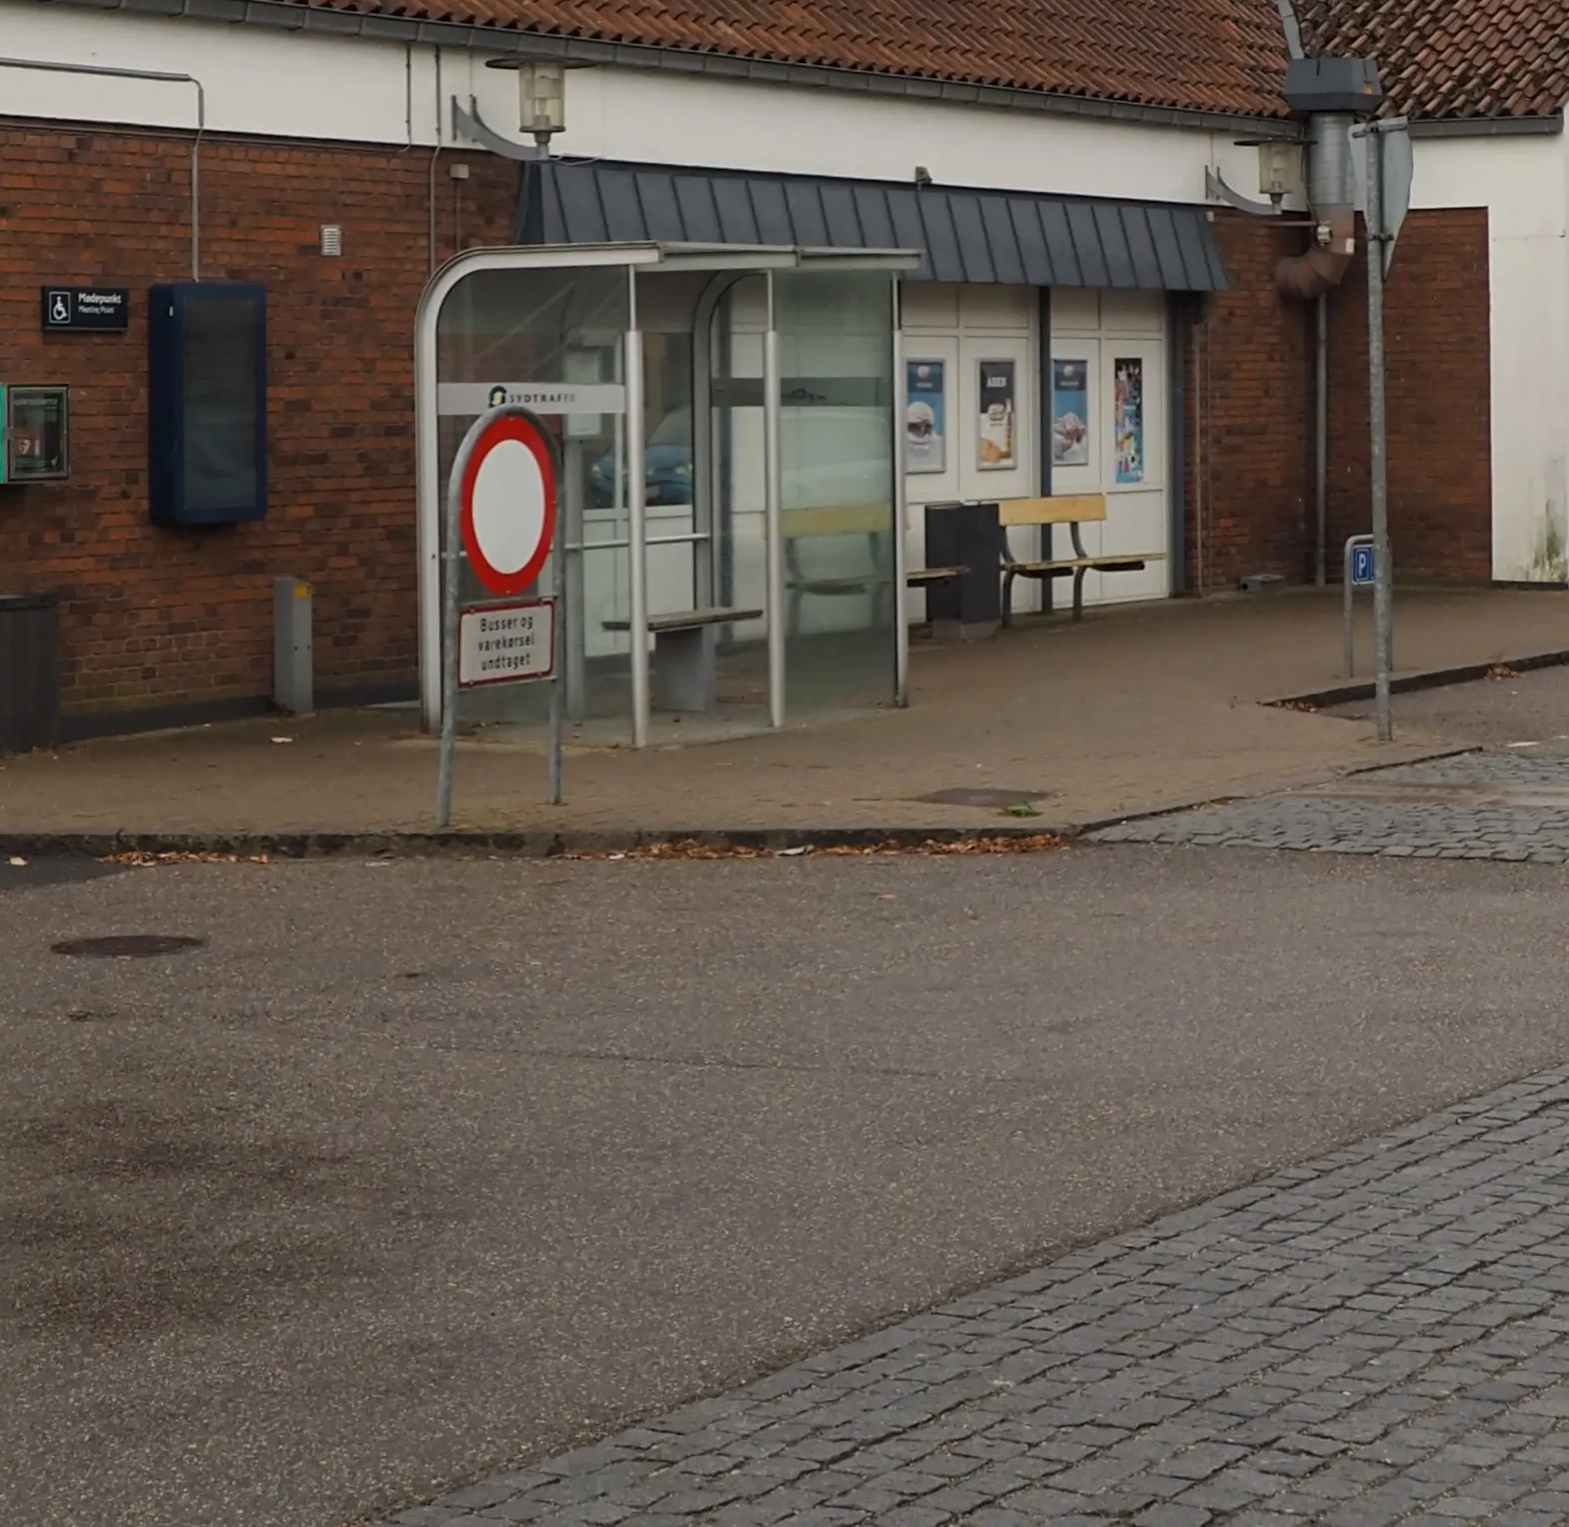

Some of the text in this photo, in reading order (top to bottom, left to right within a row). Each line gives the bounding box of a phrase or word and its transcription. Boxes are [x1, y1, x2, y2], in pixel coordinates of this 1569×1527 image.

[1359, 553, 1366, 576] P
[480, 616, 533, 632] Busser og
[478, 632, 535, 651] varekørsel
[481, 652, 531, 671] undtaget
